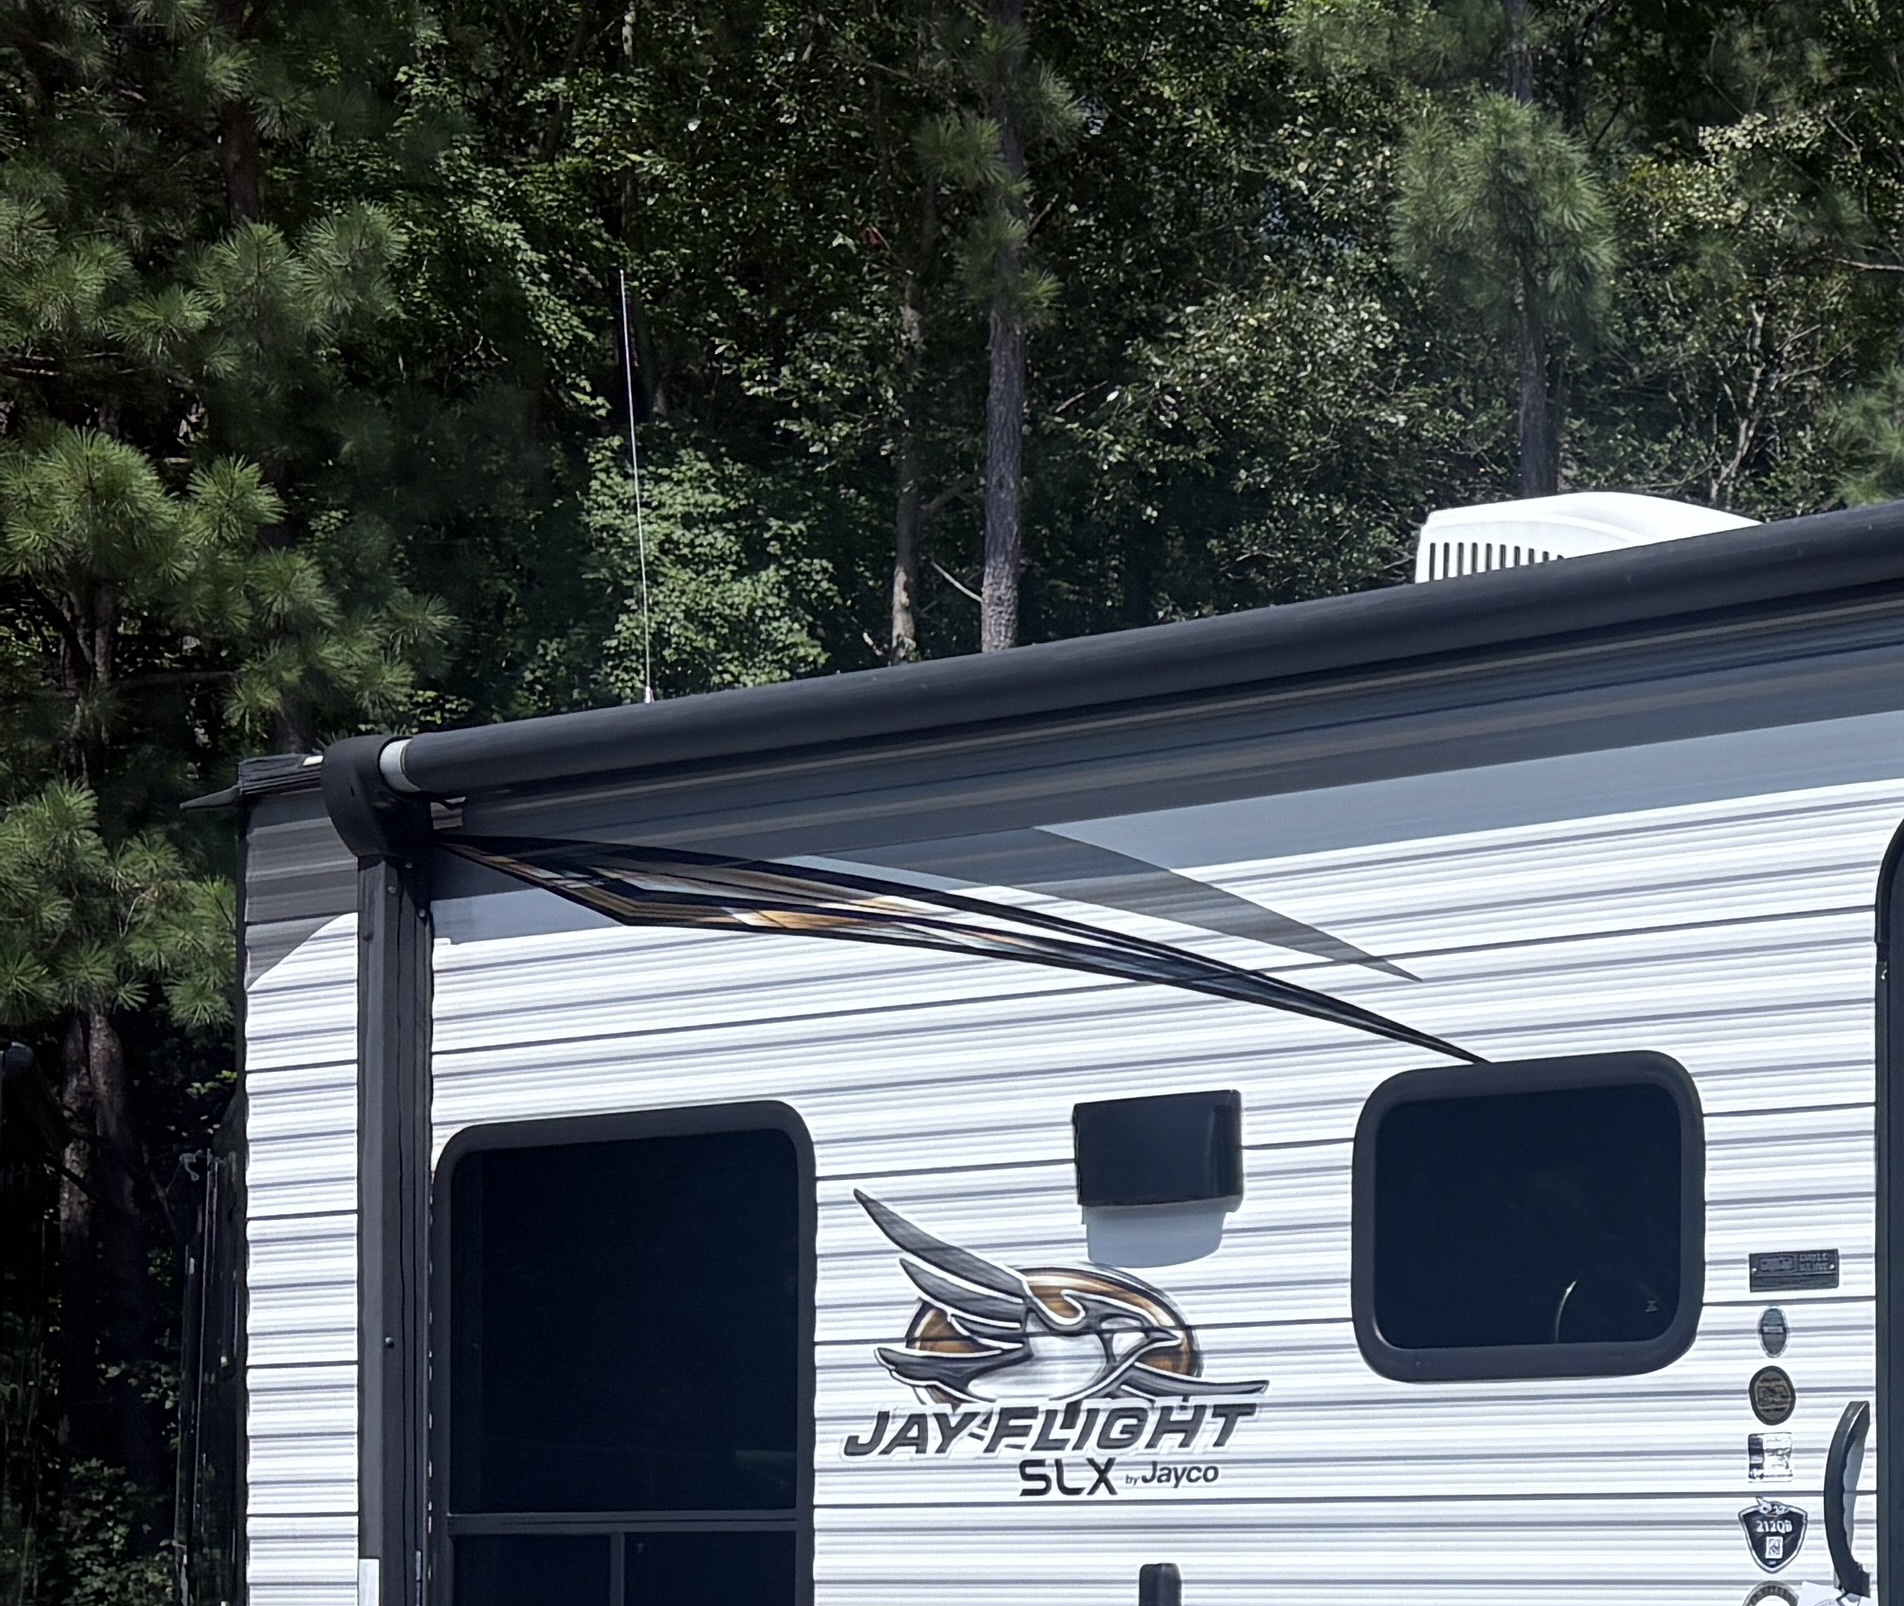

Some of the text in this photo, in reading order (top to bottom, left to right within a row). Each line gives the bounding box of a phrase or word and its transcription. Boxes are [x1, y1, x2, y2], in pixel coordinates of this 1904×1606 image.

[1019, 1457, 1118, 1497] SLX
[1141, 1460, 1219, 1488] Jayco
[1755, 1519, 1793, 1534] 212QB
